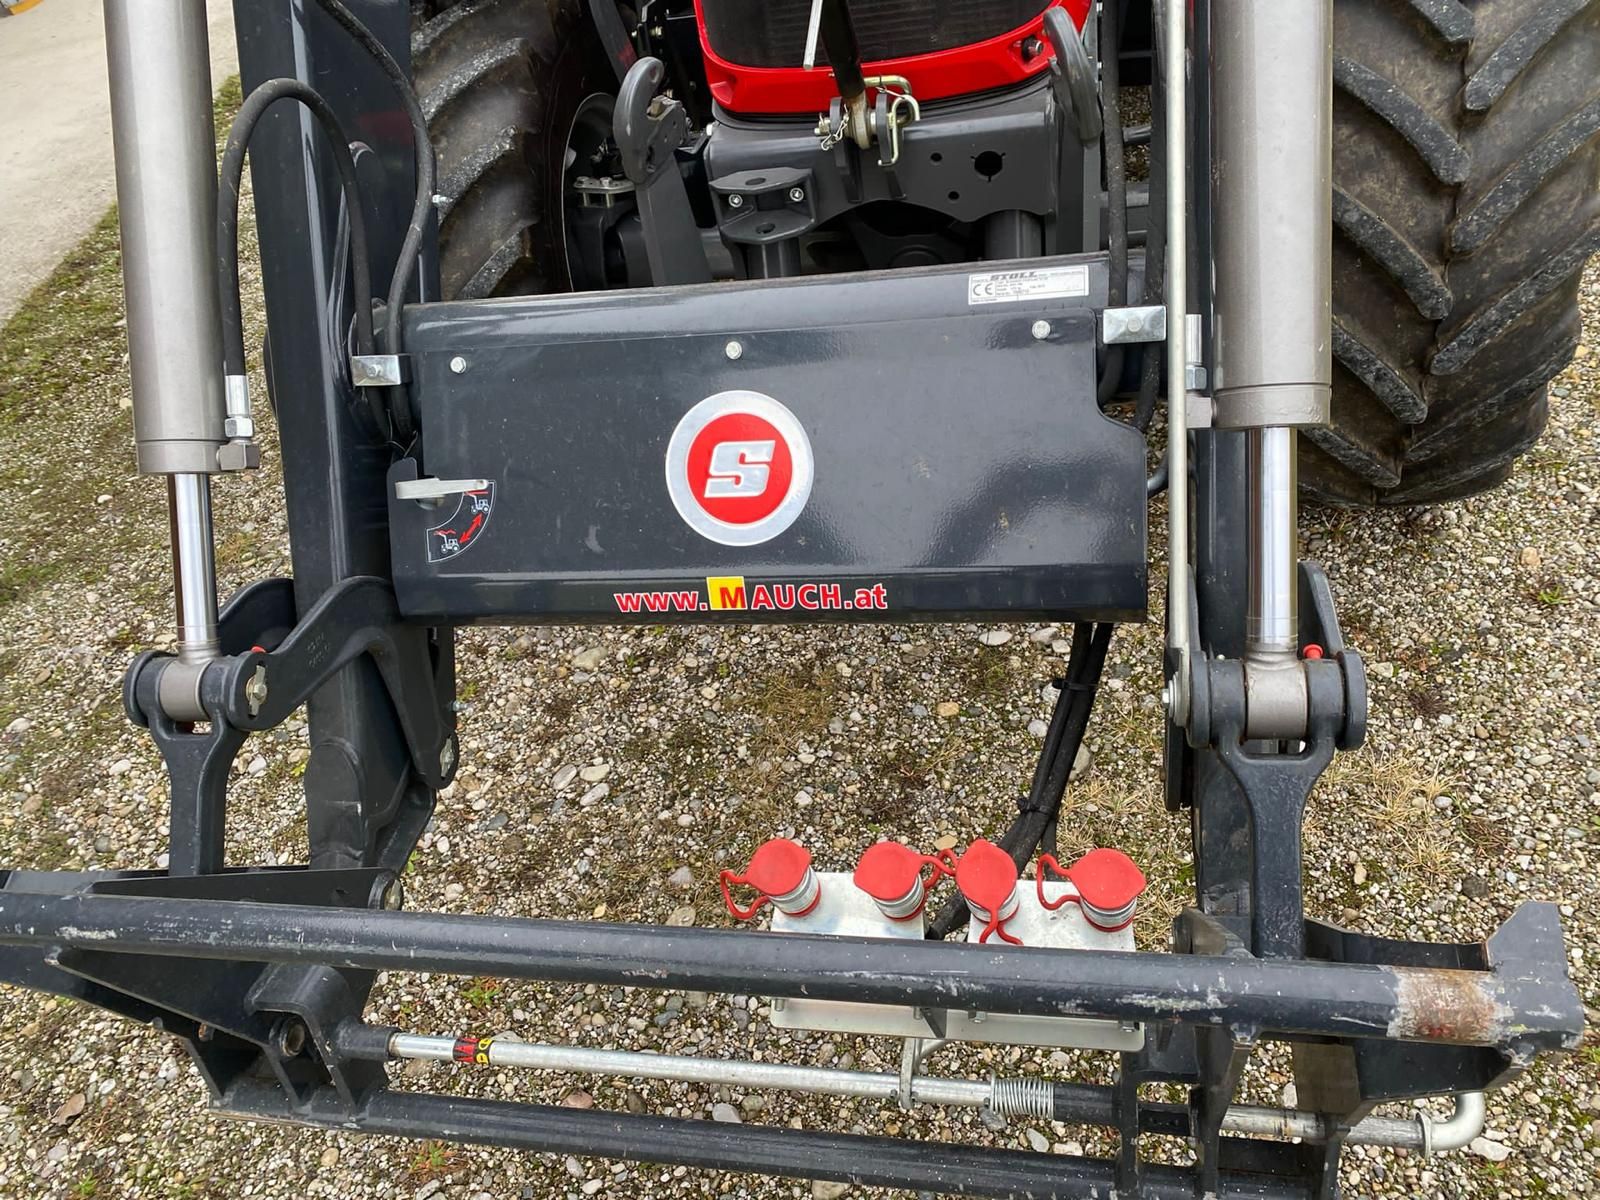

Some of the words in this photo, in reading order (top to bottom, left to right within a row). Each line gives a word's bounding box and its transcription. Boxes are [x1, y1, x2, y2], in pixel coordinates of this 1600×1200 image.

[990, 271, 1038, 281] STOLL
[704, 440, 776, 499] S
[614, 583, 888, 612] www.MAUCH.at
